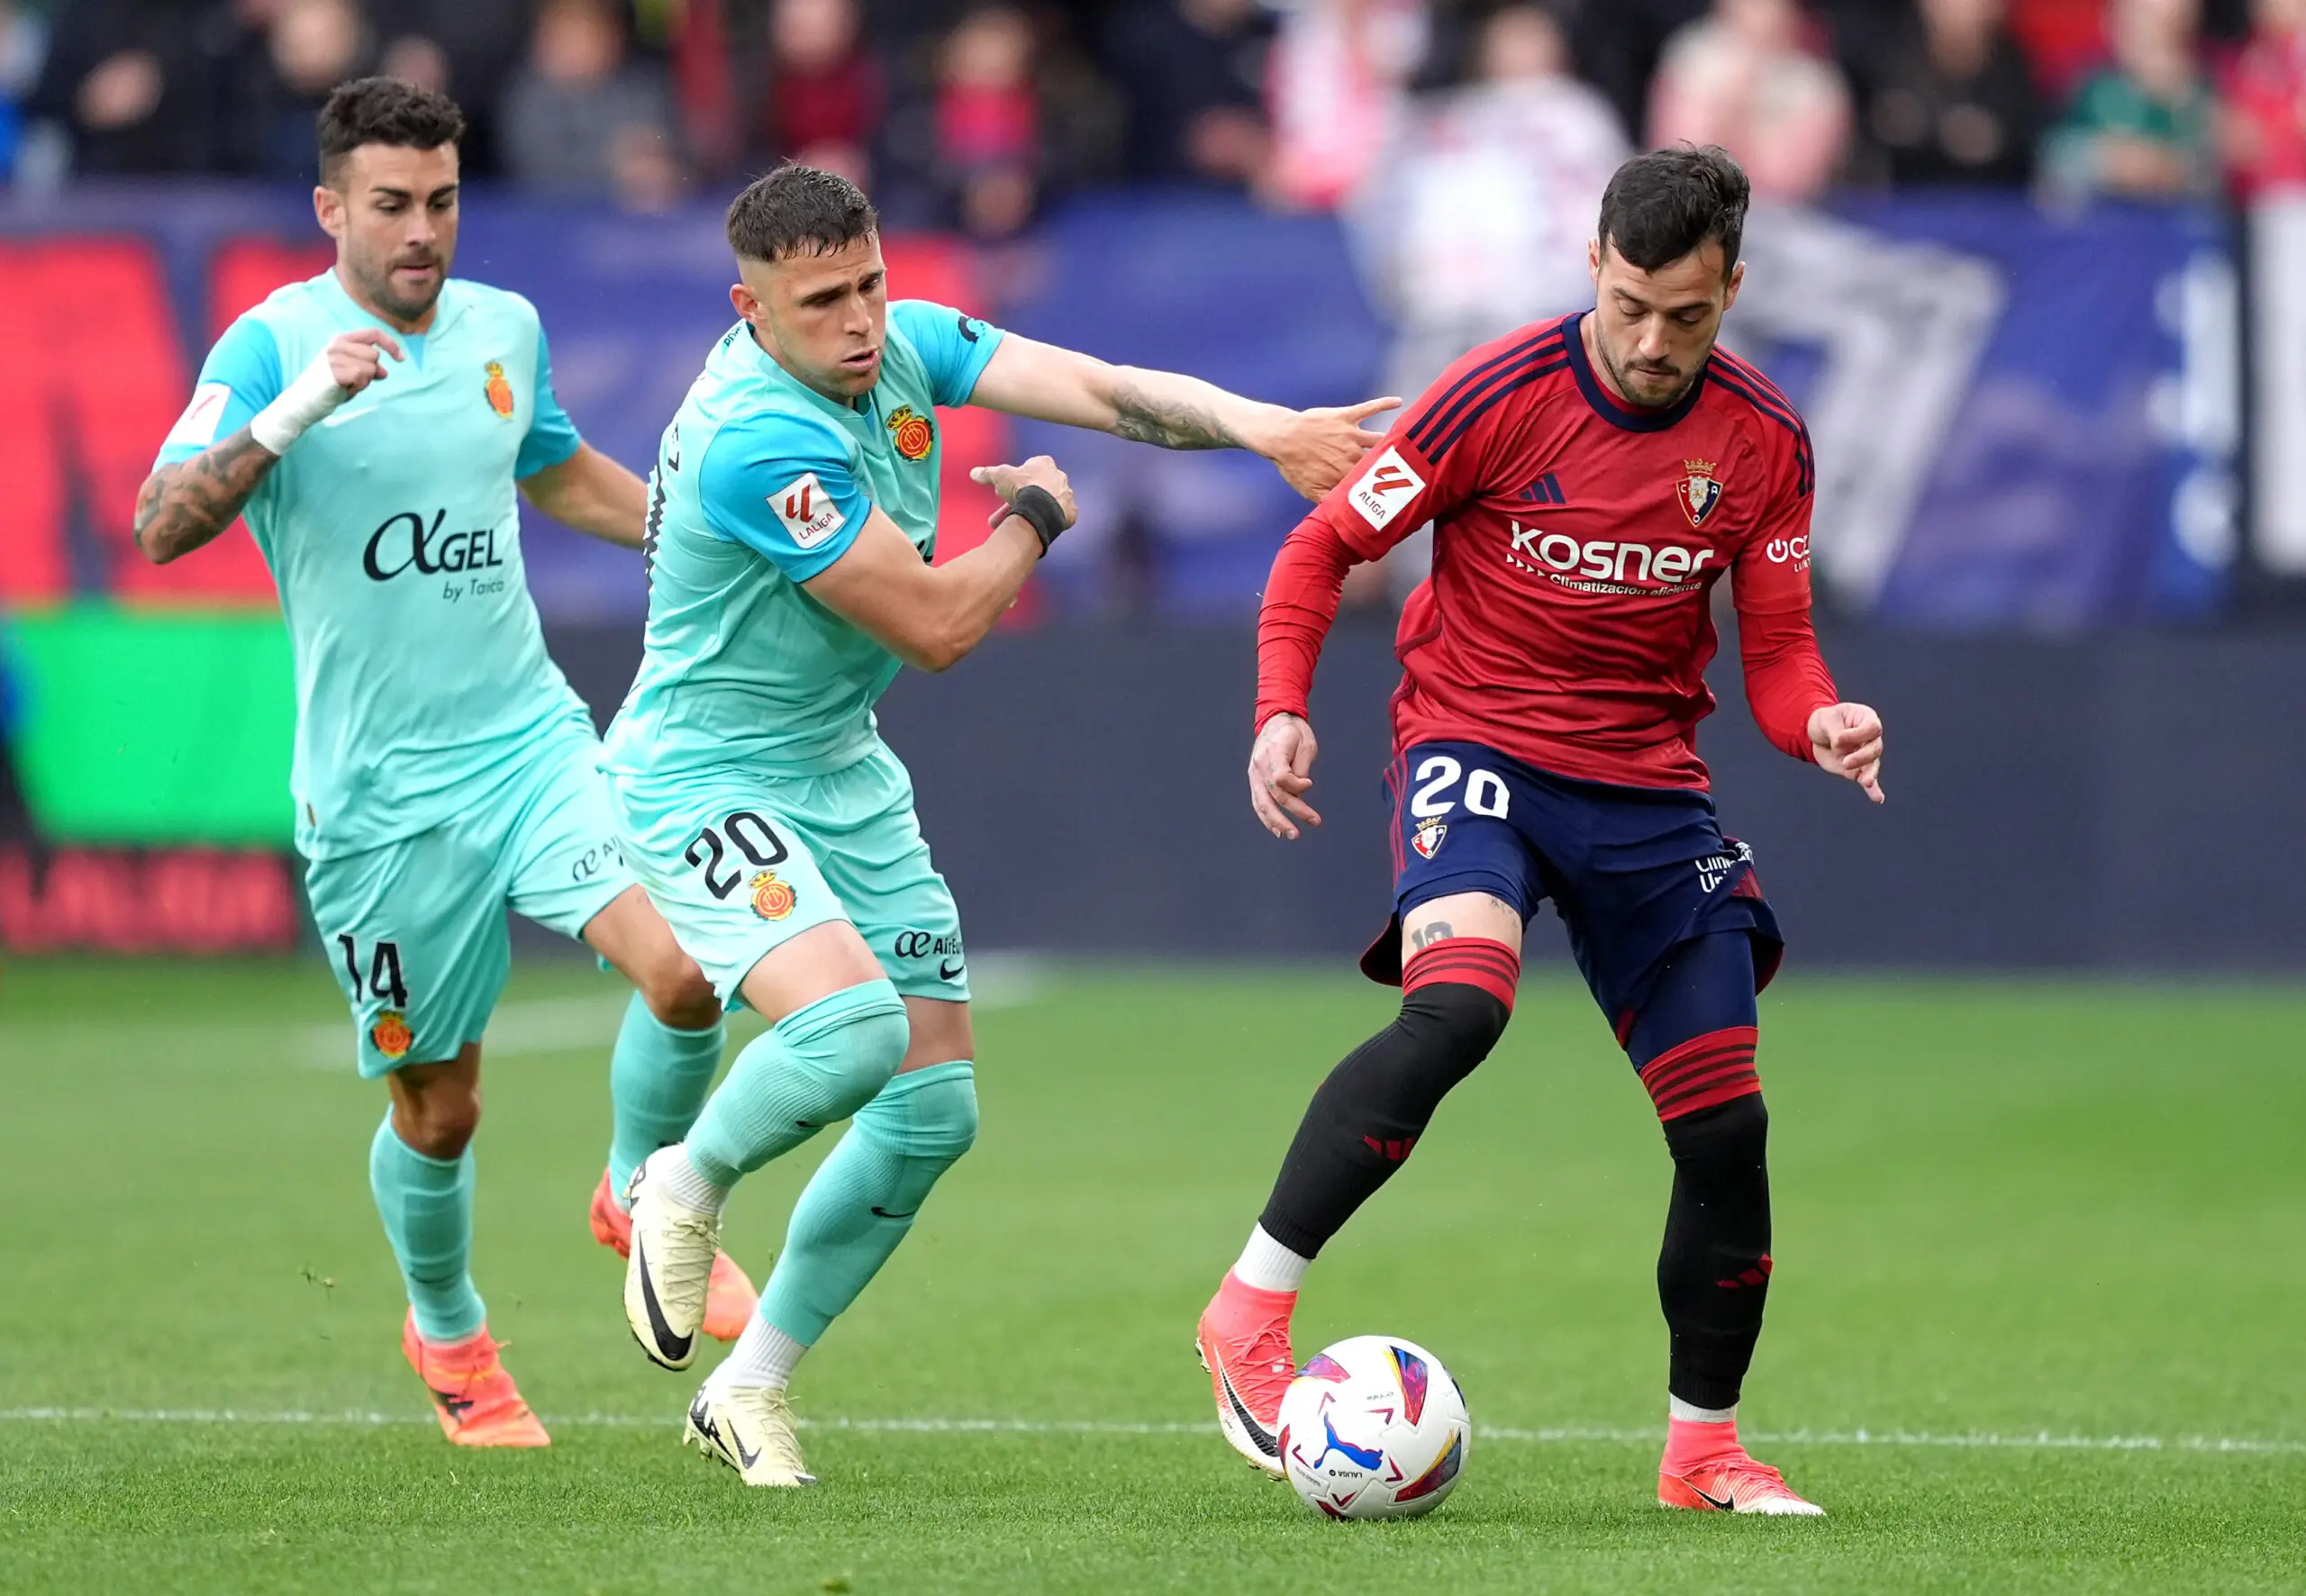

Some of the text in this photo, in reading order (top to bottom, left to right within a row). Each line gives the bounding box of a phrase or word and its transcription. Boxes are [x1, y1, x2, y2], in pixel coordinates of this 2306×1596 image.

[798, 512, 835, 540] LALIGA
[442, 581, 464, 603] by
[1411, 756, 1511, 820] 20
[685, 812, 789, 901] 20
[337, 933, 408, 1008] 14
[1337, 1469, 1363, 1479] LALIGA
